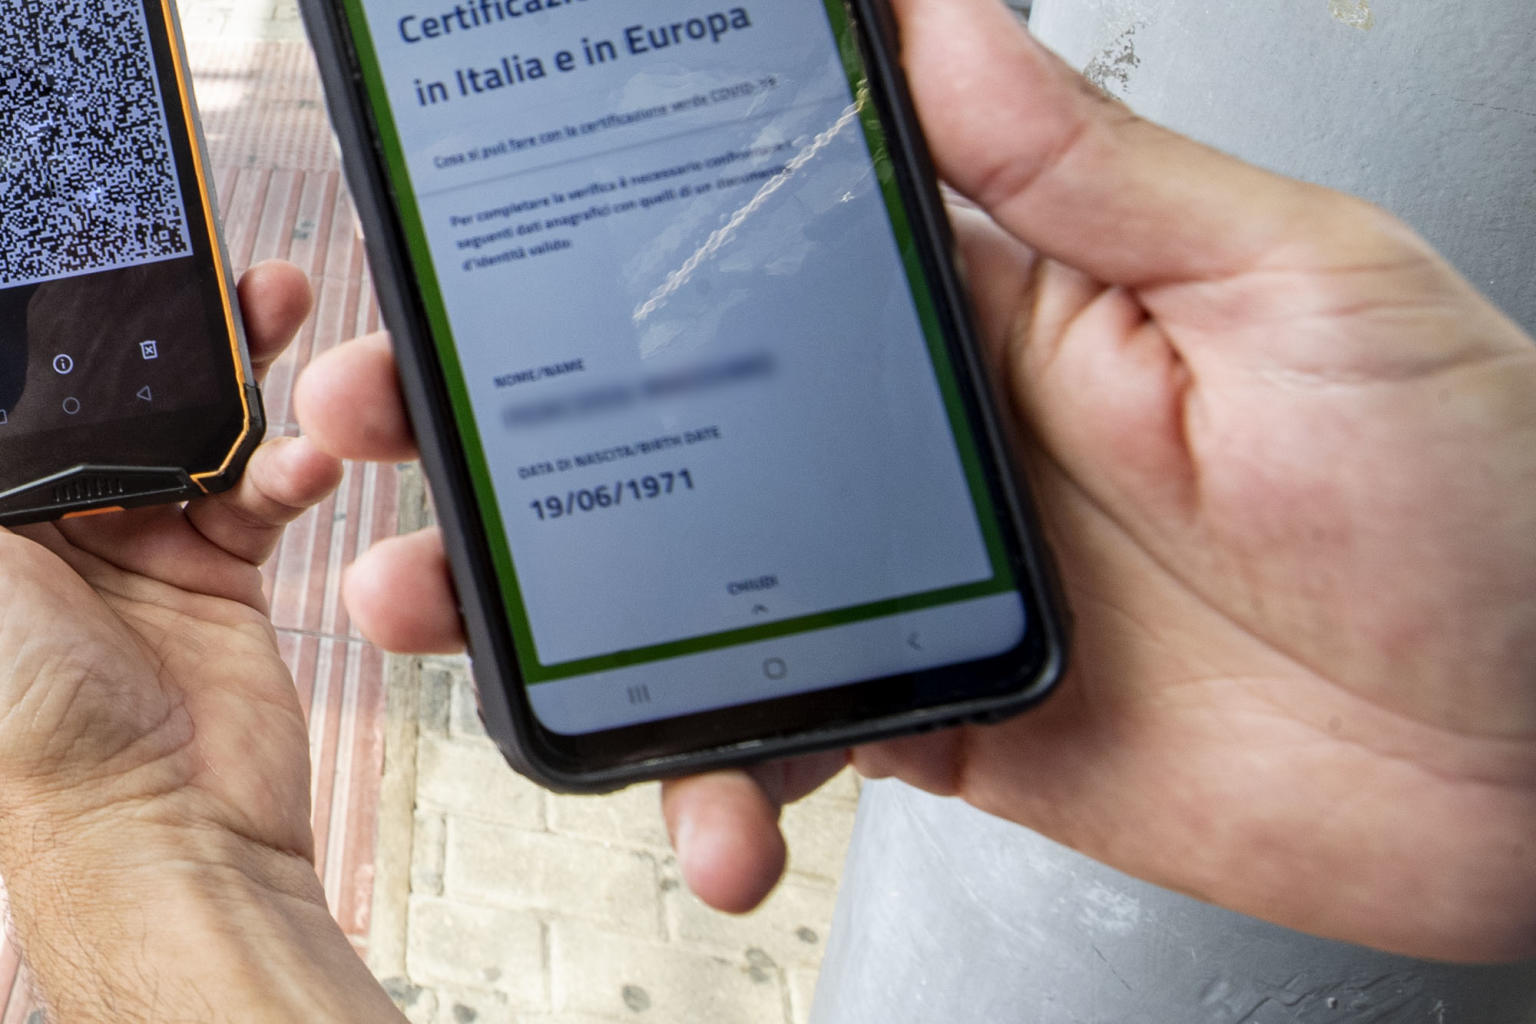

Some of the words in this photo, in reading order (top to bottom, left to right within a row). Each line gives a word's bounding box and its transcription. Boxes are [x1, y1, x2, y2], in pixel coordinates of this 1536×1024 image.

[414, 77, 450, 107] in
[456, 54, 547, 97] Italia
[555, 49, 576, 73] e
[582, 36, 618, 67] in
[624, 4, 753, 56] Europa
[508, 136, 537, 154] fare
[539, 128, 563, 145] con
[493, 357, 587, 389] NOME/NAME
[517, 463, 555, 479] DATA
[555, 458, 573, 472] DI
[573, 434, 683, 468] NASCITA/BIRTH
[683, 425, 722, 444] DATE
[529, 467, 695, 521] 19/06/1971
